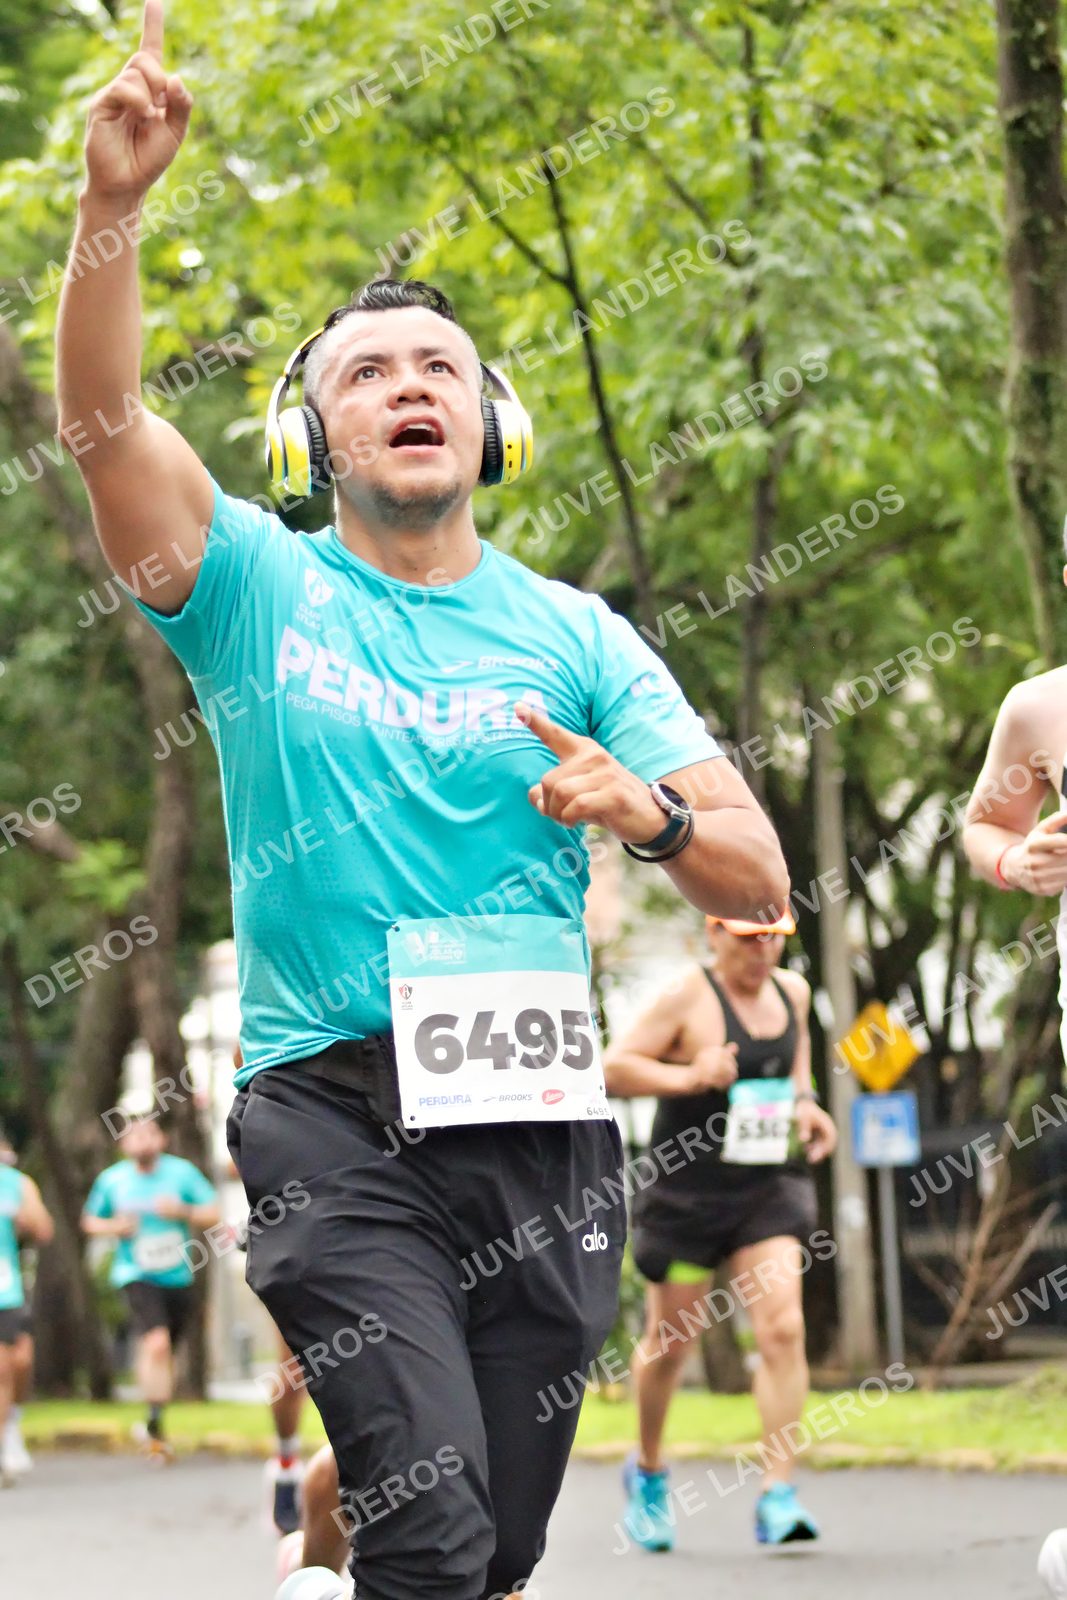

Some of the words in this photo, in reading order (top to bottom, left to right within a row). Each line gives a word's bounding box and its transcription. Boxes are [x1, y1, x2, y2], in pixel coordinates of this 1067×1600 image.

[276, 625, 550, 735] PERDURA
[286, 691, 318, 712] PEGA
[321, 703, 362, 727] PISOS
[414, 1008, 594, 1074] 6495
[419, 1094, 472, 1107] PERDURA
[499, 1093, 533, 1102] BROOKS
[582, 1222, 608, 1251] alo
